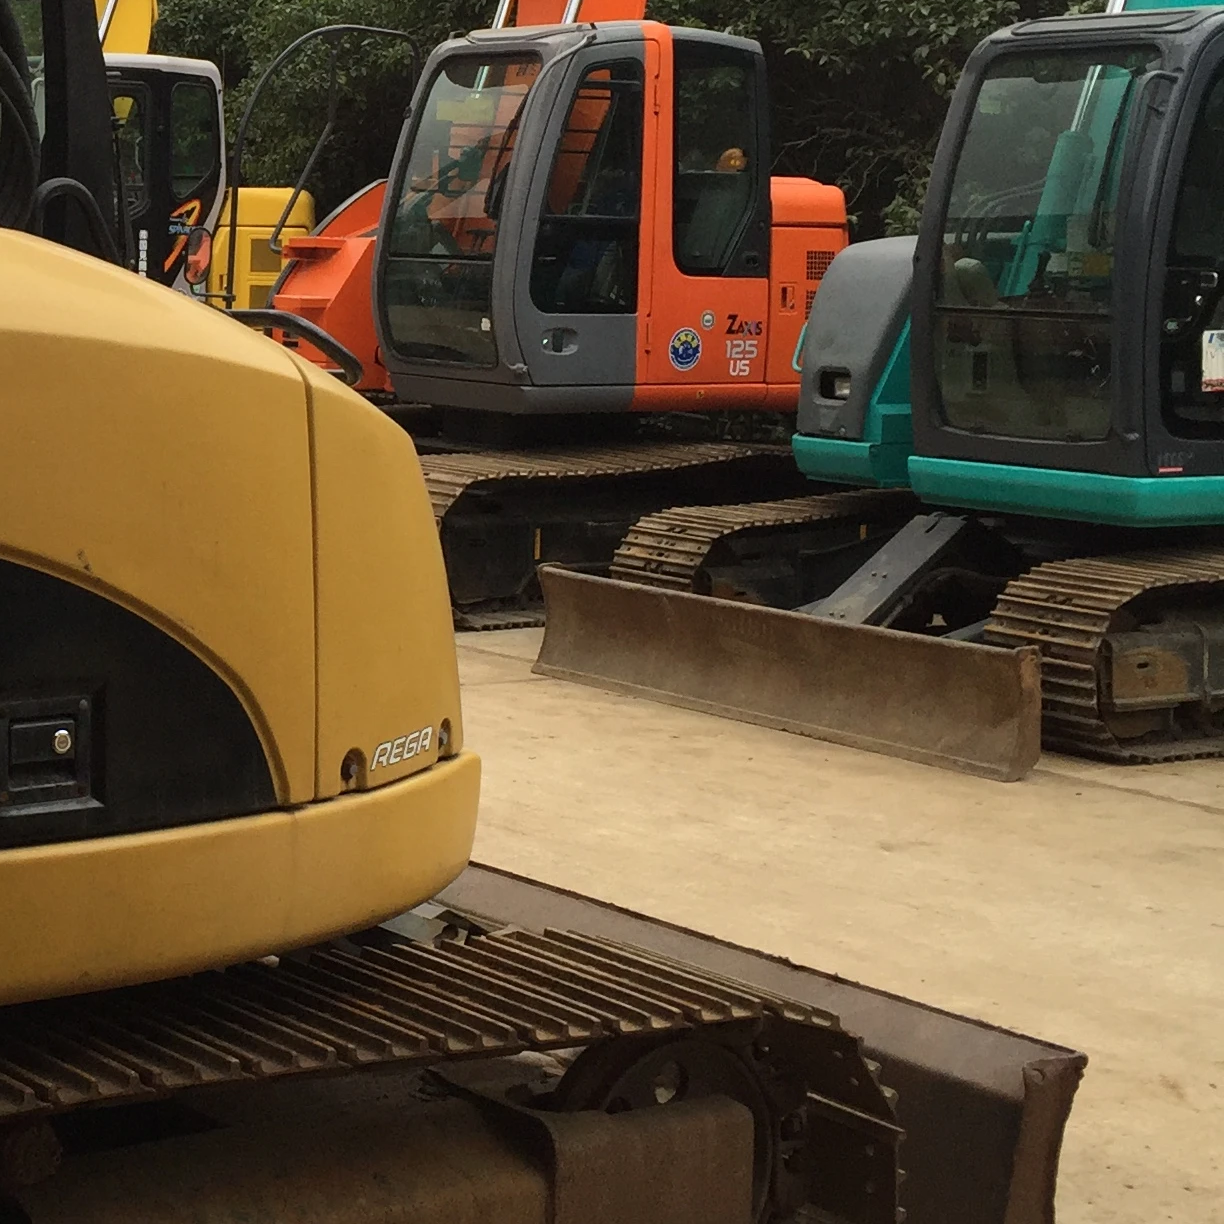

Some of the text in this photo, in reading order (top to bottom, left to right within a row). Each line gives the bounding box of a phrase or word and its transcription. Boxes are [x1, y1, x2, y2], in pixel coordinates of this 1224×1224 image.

[725, 339, 758, 359] 125
[729, 360, 750, 376] US
[370, 725, 433, 771] REGA
